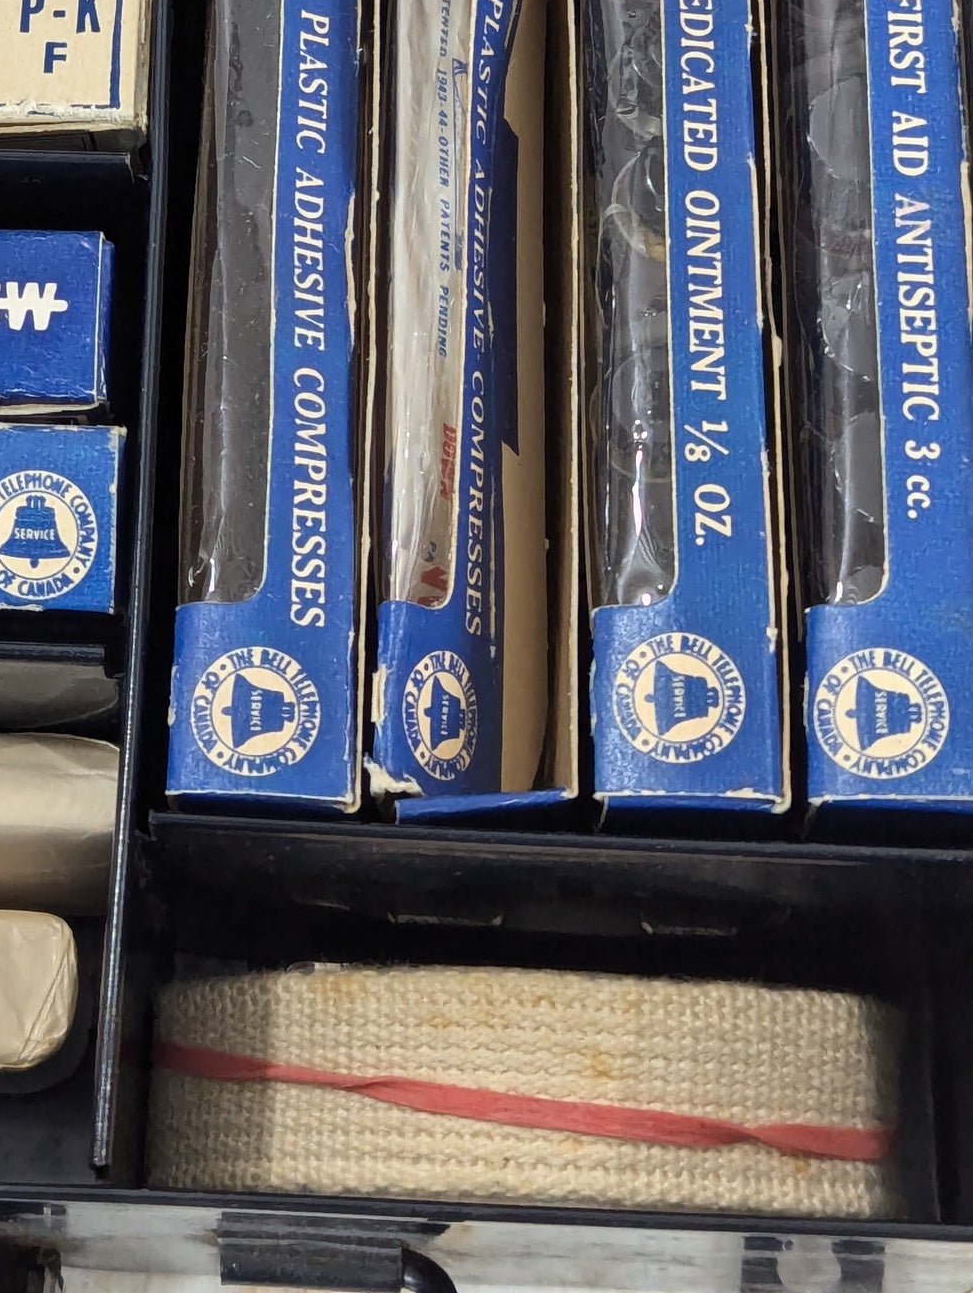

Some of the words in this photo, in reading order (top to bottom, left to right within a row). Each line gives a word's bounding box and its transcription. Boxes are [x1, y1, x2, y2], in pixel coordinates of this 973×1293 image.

[43, 41, 68, 74] F
[296, 8, 330, 151] PLASTIC
[891, 110, 929, 177] AID
[292, 166, 327, 351] ADHESIVE
[438, 198, 451, 271] PATENTS
[471, 156, 489, 354] ADHESIVE
[437, 284, 450, 358] PENDING
[685, 189, 727, 402] OINTMENT
[894, 192, 941, 423] ANTISEPTIC
[904, 438, 942, 460] 3
[13, 527, 56, 540] SERVICE
[289, 367, 327, 628] COMPRESSES
[465, 370, 485, 637] COMPRESSES
[693, 483, 732, 547] OZ.
[905, 474, 931, 520] cc.
